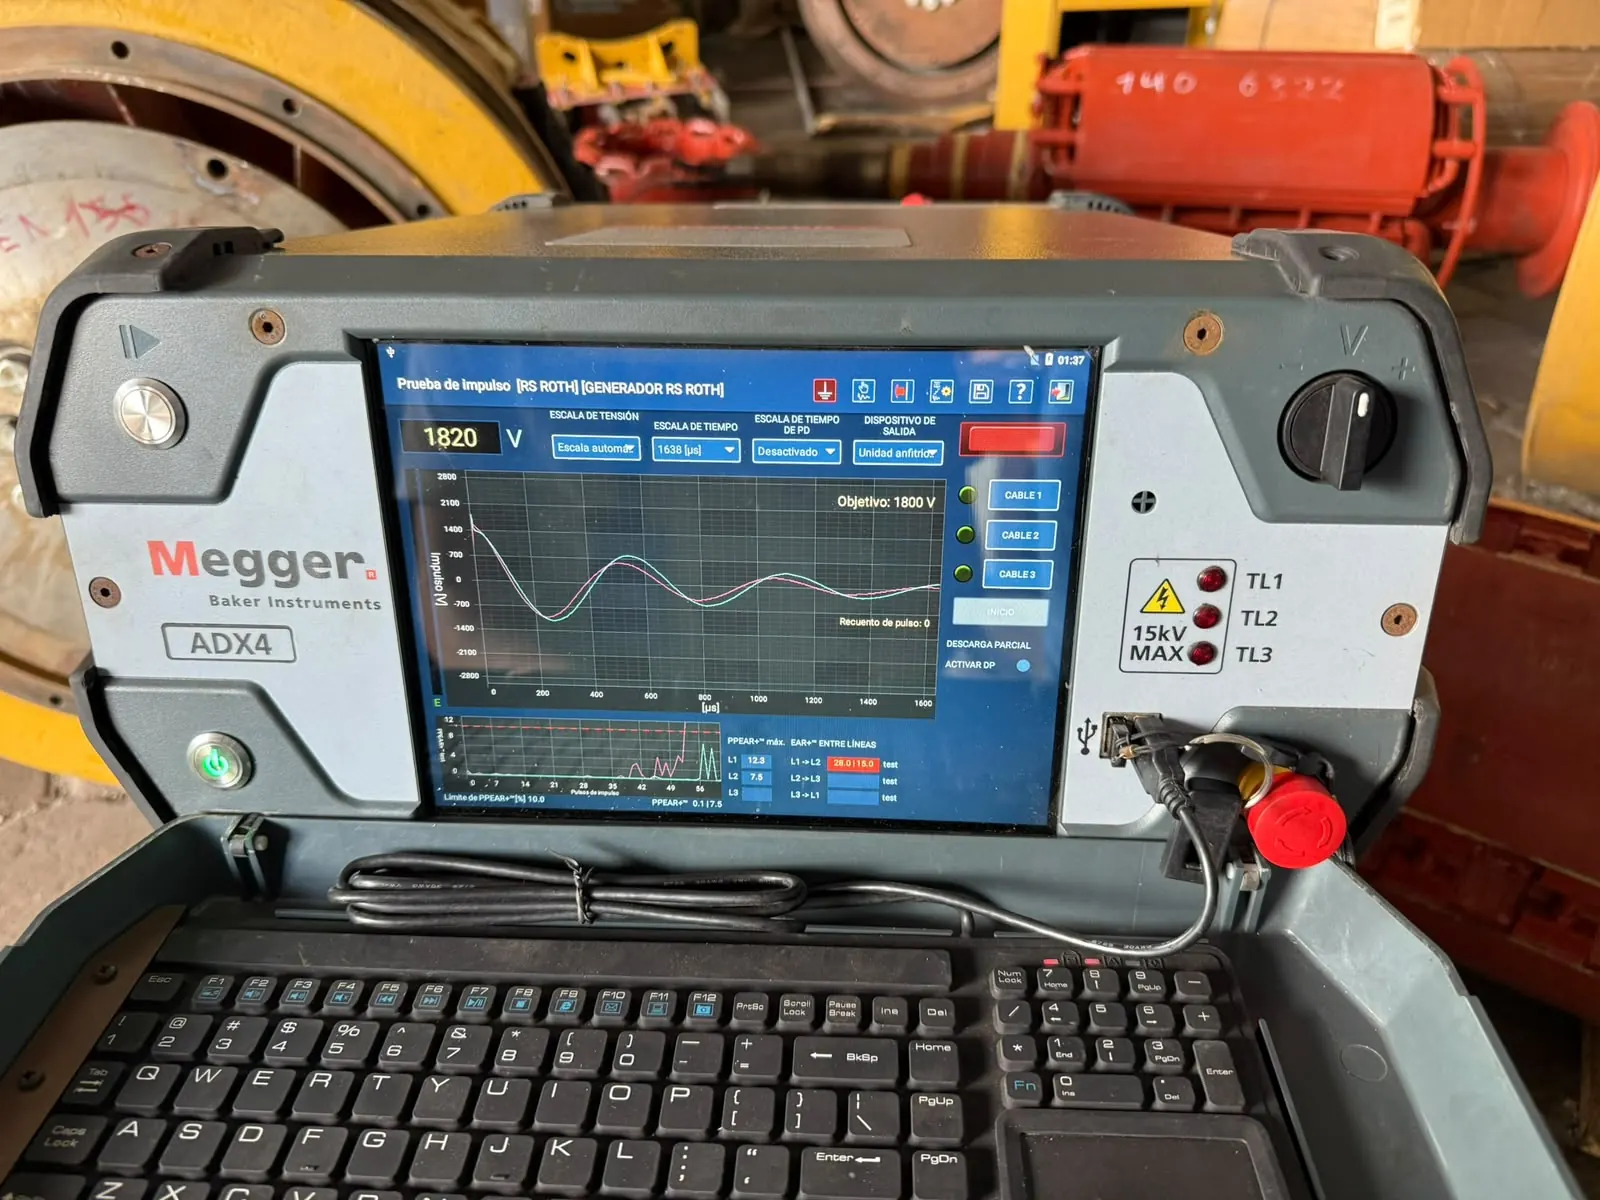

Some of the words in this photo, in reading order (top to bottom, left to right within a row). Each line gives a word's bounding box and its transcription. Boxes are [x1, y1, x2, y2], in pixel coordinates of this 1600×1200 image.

[1058, 354, 1085, 366] 01:37
[397, 377, 442, 391] Prueba
[444, 379, 460, 391] de
[462, 379, 511, 393] impulso
[517, 380, 538, 394] [RS
[540, 380, 579, 395] ROTH]
[582, 381, 663, 396] [GENERADOR
[666, 383, 683, 396] RS
[685, 382, 725, 398] ROTH]
[550, 410, 586, 421] ESCALA
[587, 411, 599, 421] DE
[599, 409, 639, 422] TENSIÓN
[755, 414, 788, 424] ESCALA
[789, 415, 803, 424] DE
[804, 415, 840, 425] TIEMPO
[864, 415, 922, 426] DISPOSITIVO
[924, 416, 936, 426] DE
[654, 421, 688, 431] ESCALA
[690, 422, 701, 431] DE
[702, 422, 738, 432] TIEMPO
[784, 425, 795, 435] DE
[798, 426, 810, 435] PD
[883, 426, 916, 437] SALIDA
[424, 427, 478, 448] 1820
[505, 428, 522, 448] V
[557, 442, 590, 453] Escala
[657, 444, 682, 455] 1638
[758, 446, 818, 458] Desactivado
[858, 448, 893, 459] Unidad
[1005, 490, 1035, 500] CABLE
[440, 499, 460, 507] 2100
[837, 496, 891, 511] Objetivo:
[894, 496, 924, 509] 1800
[926, 497, 936, 509] V
[444, 525, 463, 533] 1400
[1002, 530, 1031, 540] CABLE
[1033, 531, 1039, 540] 2
[147, 540, 366, 589] Megger
[430, 552, 445, 592] Impulso
[999, 570, 1029, 579] CABLE
[1030, 570, 1036, 579] 3
[1247, 572, 1284, 590] TL1
[209, 595, 261, 608] Baker
[268, 596, 382, 610] Instruments
[840, 617, 880, 627] Recuento
[882, 618, 893, 627] de
[895, 618, 922, 629] pulso:
[924, 619, 931, 628] 0
[1241, 610, 1278, 627] TL2
[454, 624, 474, 632] -1400
[1133, 625, 1187, 642] 15kV
[190, 632, 273, 656] ADX4
[946, 640, 993, 649] DESCARGA
[994, 640, 1032, 650] PARCIAL
[1130, 645, 1184, 662] MAX
[1236, 646, 1273, 663] TL3
[945, 660, 982, 669] ACTIVAR
[983, 661, 996, 670] DP
[536, 689, 550, 697] 200
[644, 692, 658, 700] 600
[698, 693, 712, 701] 800
[750, 695, 768, 703] 1000
[859, 698, 878, 706] 1400
[914, 699, 933, 707] 1600
[818, 739, 846, 748] ENTRE
[846, 738, 877, 749] LÍNEAS
[727, 756, 738, 764] L1
[748, 756, 766, 764] 12.3
[882, 760, 899, 769] test
[728, 772, 739, 780] L2
[750, 773, 763, 781] 7.5
[882, 777, 898, 786] test
[637, 783, 647, 791] 42
[666, 784, 676, 792] 49
[728, 789, 739, 797] L3
[444, 793, 467, 801] Límite
[528, 795, 545, 803] 10.0
[881, 793, 898, 802] test
[208, 977, 225, 985] F1
[250, 979, 269, 987] F2
[294, 980, 312, 988] F3
[337, 982, 355, 990] F4
[381, 983, 399, 992] F5
[425, 985, 444, 993] F6
[471, 987, 489, 995] F7
[515, 988, 533, 996] F8
[1138, 984, 1162, 992] PgUp
[560, 990, 578, 998] F9
[602, 991, 626, 1000] F10
[650, 992, 669, 1001] F11
[693, 993, 717, 1001] F12
[783, 1000, 811, 1008] Scroll
[829, 1001, 856, 1009] Pause
[783, 1008, 806, 1016] Lock
[829, 1009, 856, 1018] Break
[880, 1007, 899, 1016] Ins
[927, 1008, 948, 1017] Del
[915, 1042, 952, 1052] Home
[846, 1052, 879, 1063] BkSp
[1155, 1054, 1181, 1063] PgDn
[88, 1067, 109, 1077] Tab
[136, 1066, 160, 1080] Q
[194, 1068, 222, 1084] W
[1206, 1067, 1234, 1076] Enter
[252, 1070, 275, 1086] E
[309, 1072, 332, 1088] R
[371, 1075, 391, 1091] T
[431, 1077, 450, 1093] Y
[487, 1080, 509, 1096] U
[551, 1082, 558, 1098] I
[1014, 1079, 1037, 1091] Fn
[609, 1085, 632, 1101] O
[670, 1087, 691, 1103] P
[918, 1096, 954, 1107] PgUp
[52, 1126, 88, 1137] Caps
[116, 1120, 139, 1137] A
[178, 1123, 202, 1140] S
[238, 1126, 264, 1142] D
[301, 1128, 324, 1145] F
[362, 1131, 387, 1148] G
[424, 1134, 449, 1150] H
[44, 1137, 79, 1148] Lock
[489, 1136, 510, 1153] J
[550, 1139, 574, 1156] K
[616, 1142, 633, 1159] L
[816, 1152, 854, 1163] Enter
[921, 1153, 958, 1165] PgDn
